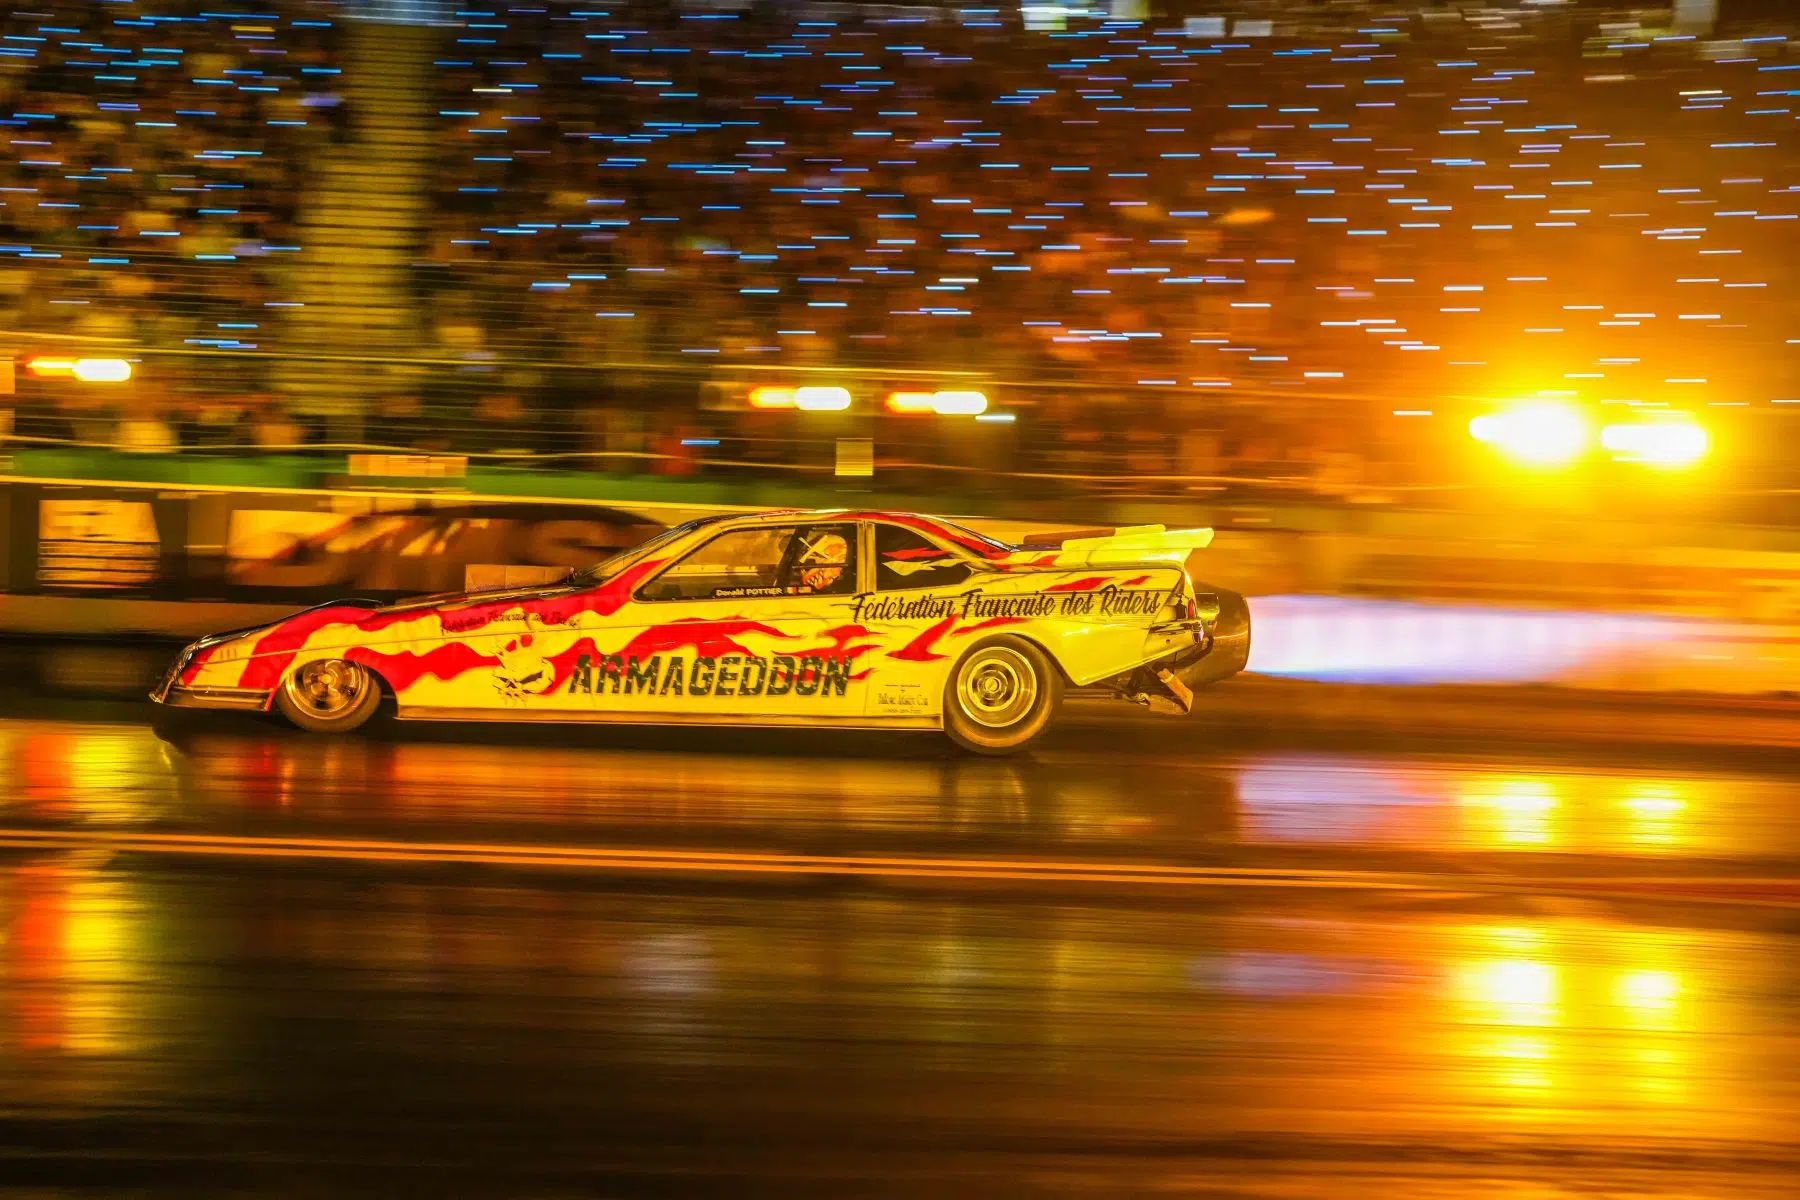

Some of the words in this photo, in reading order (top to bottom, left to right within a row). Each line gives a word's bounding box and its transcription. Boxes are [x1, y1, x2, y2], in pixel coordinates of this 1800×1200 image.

[716, 589, 744, 597] Donald
[746, 587, 783, 596] POTTIER
[851, 592, 955, 623] Fédération
[960, 588, 1056, 620] Française
[1060, 591, 1094, 616] des
[1099, 584, 1161, 618] Riders
[568, 654, 852, 696] ARMAGEDDON
